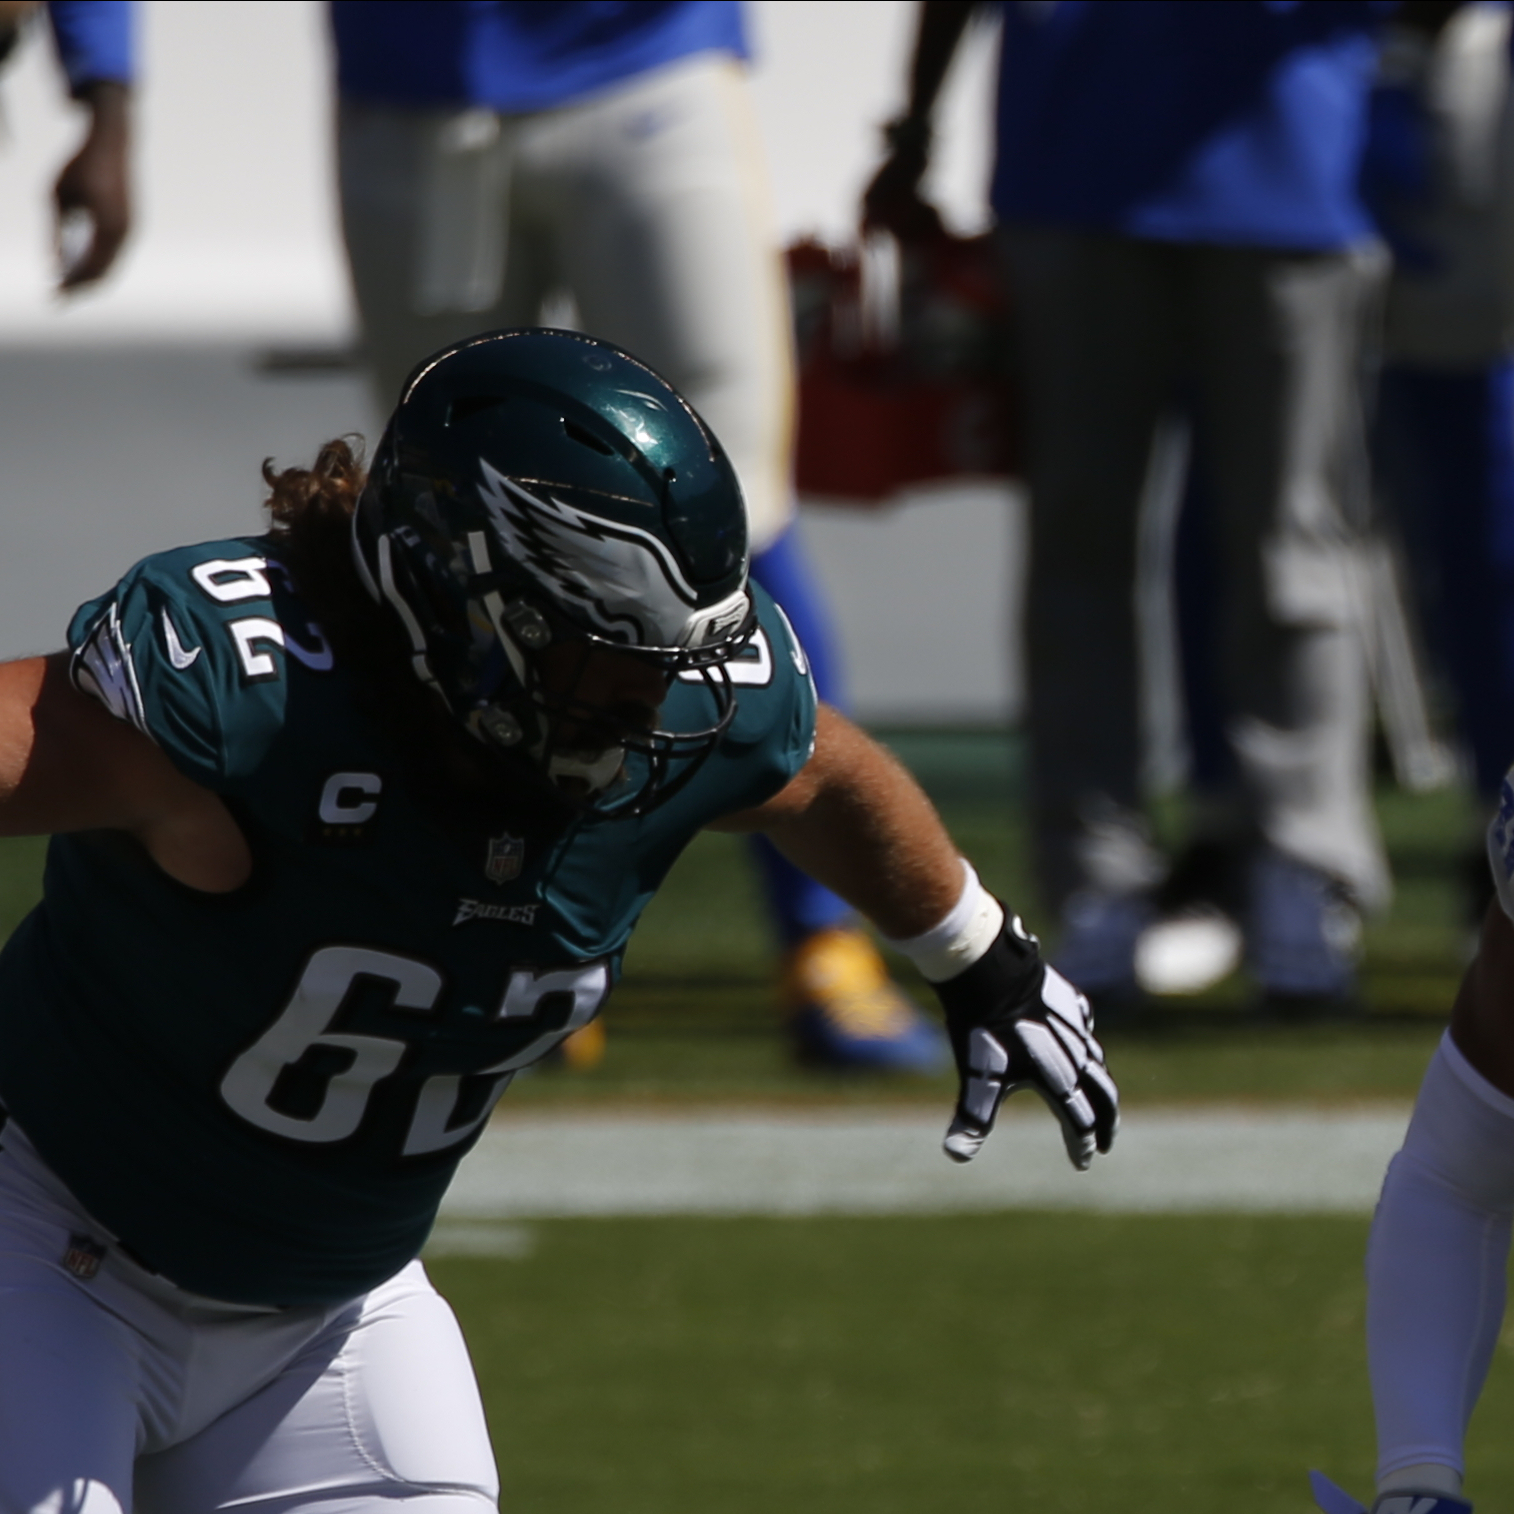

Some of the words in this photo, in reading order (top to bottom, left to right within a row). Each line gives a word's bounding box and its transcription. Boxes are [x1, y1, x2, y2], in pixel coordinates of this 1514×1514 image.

[191, 556, 335, 676] 62
[319, 772, 382, 823] C
[220, 944, 608, 1157] 62
